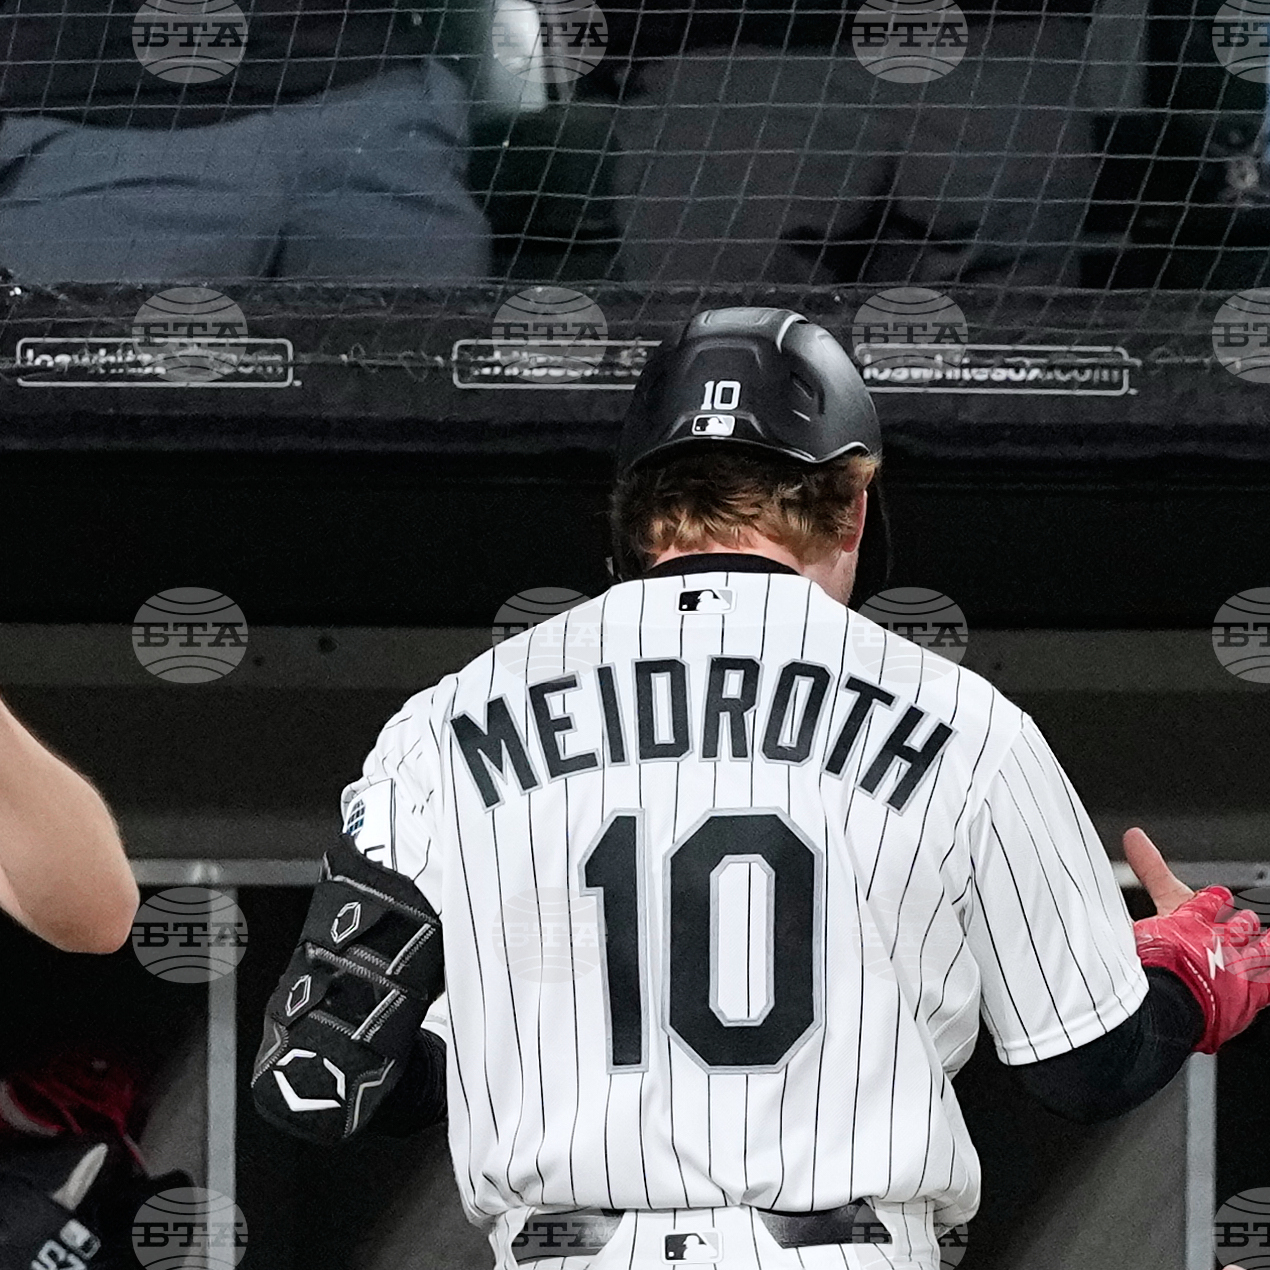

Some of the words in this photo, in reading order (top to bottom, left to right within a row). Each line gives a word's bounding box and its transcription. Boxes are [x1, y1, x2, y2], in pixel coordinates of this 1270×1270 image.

[701, 380, 741, 411] 10
[447, 655, 958, 817] MEIDROTH
[578, 807, 823, 1075] 10
